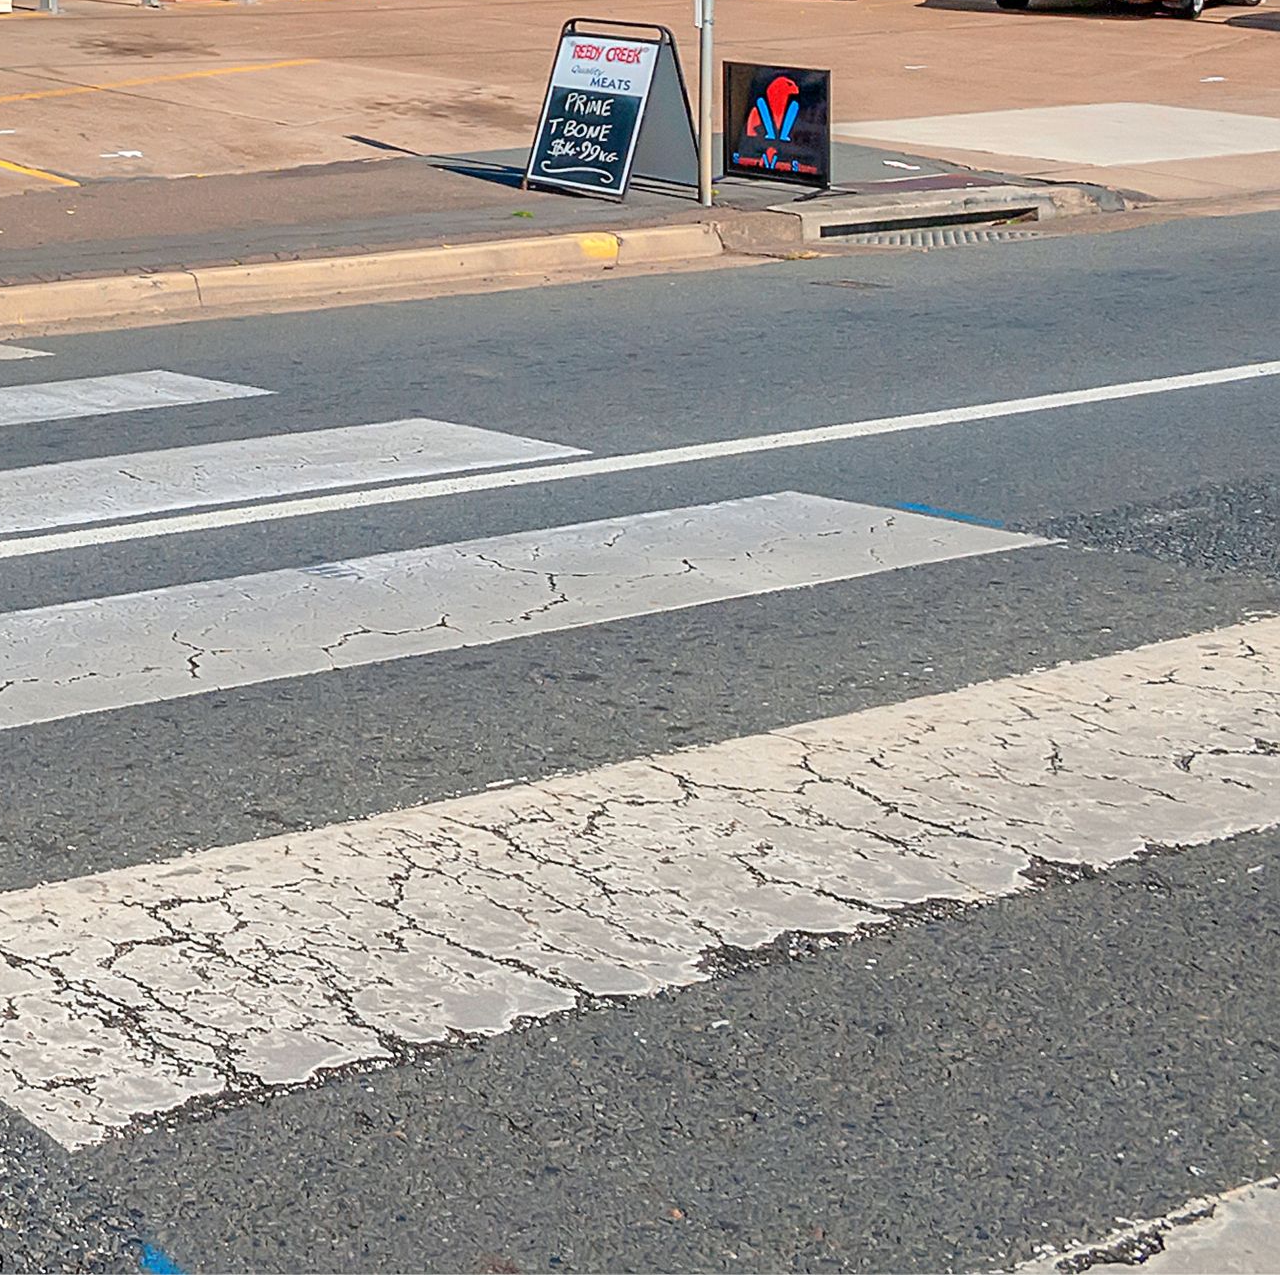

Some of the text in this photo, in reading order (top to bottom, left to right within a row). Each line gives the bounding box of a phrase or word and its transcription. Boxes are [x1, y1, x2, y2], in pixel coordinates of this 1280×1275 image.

[572, 44, 643, 64] REEDY CREEK
[571, 64, 605, 76] Quality
[590, 77, 632, 91] MEATS
